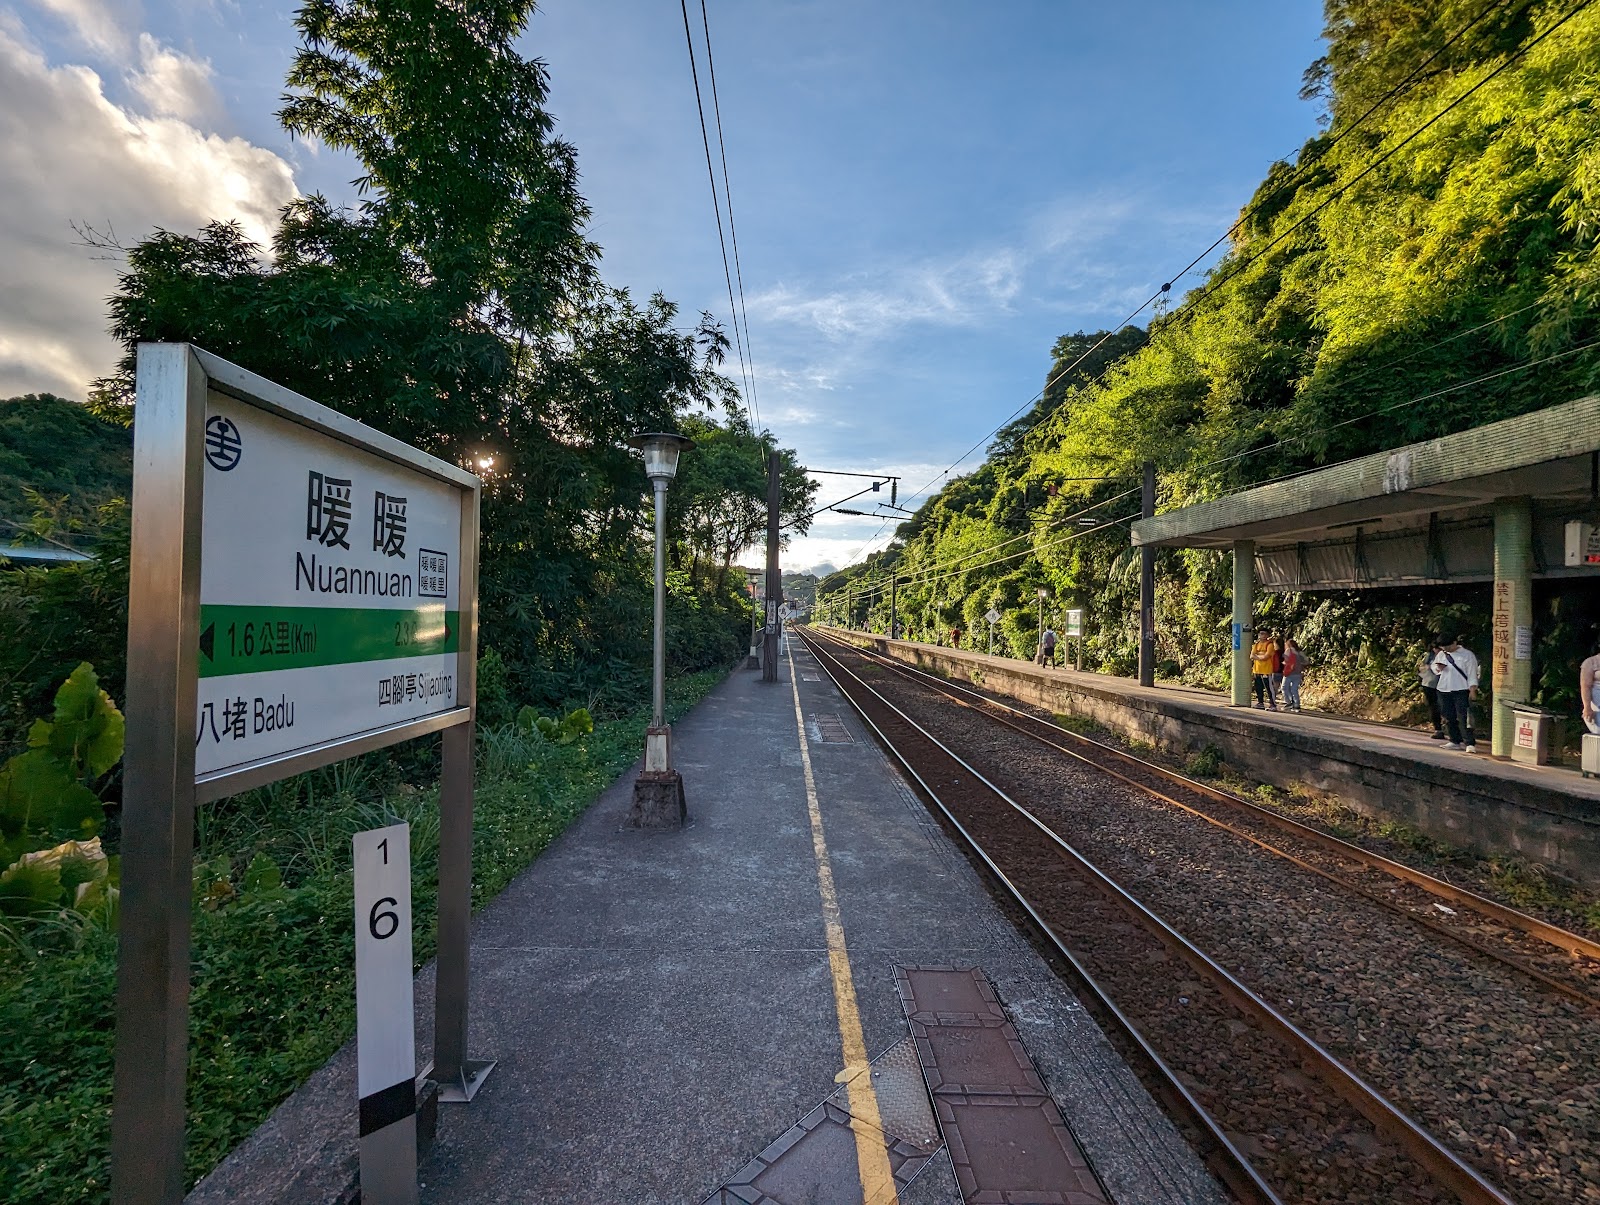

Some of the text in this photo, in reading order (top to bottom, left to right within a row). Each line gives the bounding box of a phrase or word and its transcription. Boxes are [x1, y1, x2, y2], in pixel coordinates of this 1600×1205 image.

[307, 470, 407, 559] 暖暖
[296, 552, 411, 597] Nuannuan
[228, 622, 254, 656] 1.6
[379, 673, 416, 708] 四腳亭
[196, 694, 294, 747] 八堵 Badu
[377, 838, 388, 864] 1
[369, 897, 399, 939] 6
